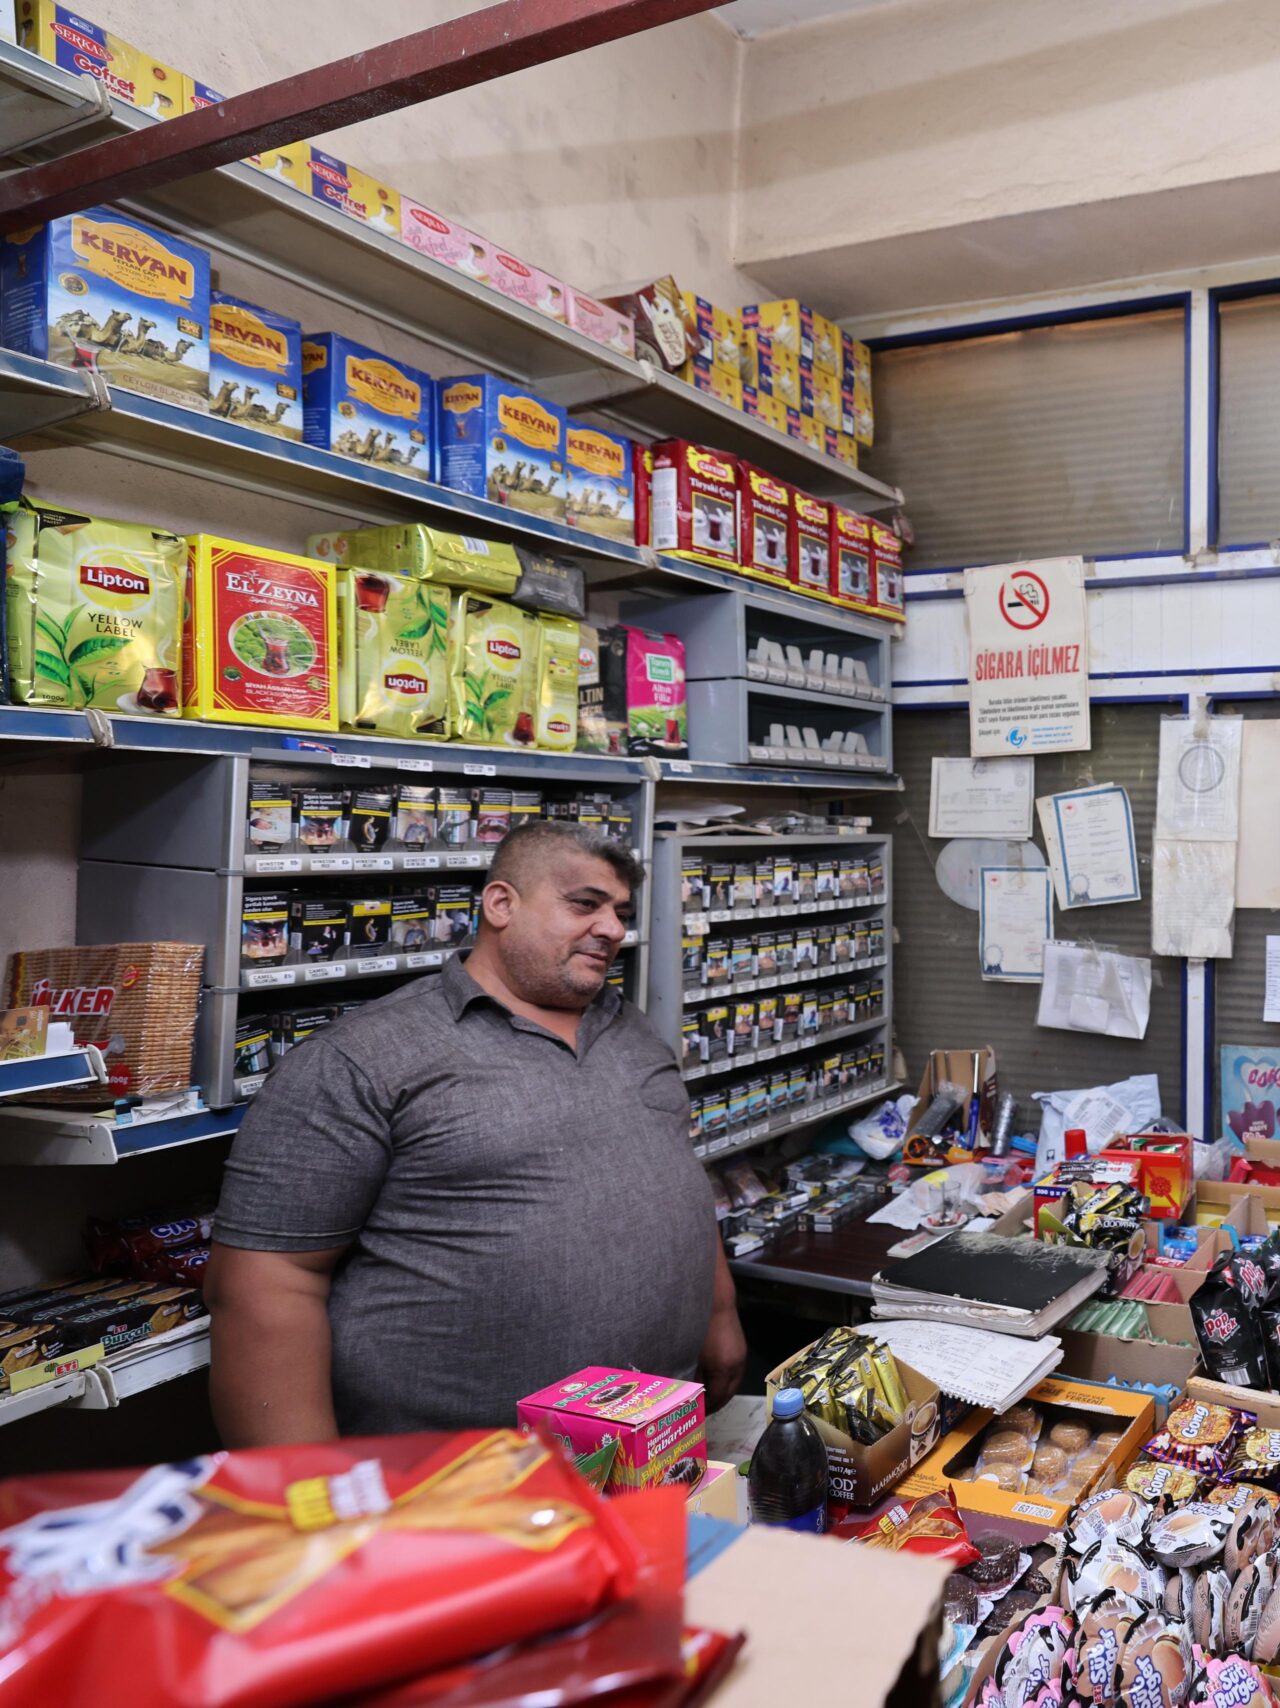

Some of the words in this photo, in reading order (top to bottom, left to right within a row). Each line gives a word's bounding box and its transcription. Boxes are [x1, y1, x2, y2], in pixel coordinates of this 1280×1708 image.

[74, 54, 135, 94] Gofret
[323, 185, 367, 213] Gofret
[81, 229, 187, 286] KERVAN
[303, 350, 325, 364] VAN
[352, 366, 417, 403] KERVAN
[503, 405, 557, 437] KERVAN
[568, 437, 622, 464] KERVAN
[689, 477, 717, 493] Tiryaki
[87, 568, 145, 593] Lipton
[226, 572, 254, 594] EL
[258, 579, 319, 608] ZEYNA
[88, 612, 143, 629] YELLOW
[96, 624, 136, 638] LABEL
[489, 642, 520, 657] Lipton
[976, 648, 1023, 681] SİGARA
[1027, 643, 1080, 680] İÇİLMEZ
[388, 676, 425, 692] Lipton
[101, 1321, 153, 1347] Burçak
[553, 1373, 624, 1408] FUNDA
[605, 1380, 663, 1419] Kabartma
[657, 1399, 698, 1431] FUNDA
[1182, 1404, 1210, 1439] Gong
[647, 1414, 697, 1460] Kabartma
[647, 1426, 673, 1448] Hamur
[673, 1431, 702, 1457] Powder
[871, 1458, 909, 1497] MAHMOOD
[1142, 1466, 1173, 1500] Gong
[1226, 1485, 1253, 1513] Gong
[1087, 1643, 1107, 1685] Süt
[1218, 1662, 1250, 1691] Süt
